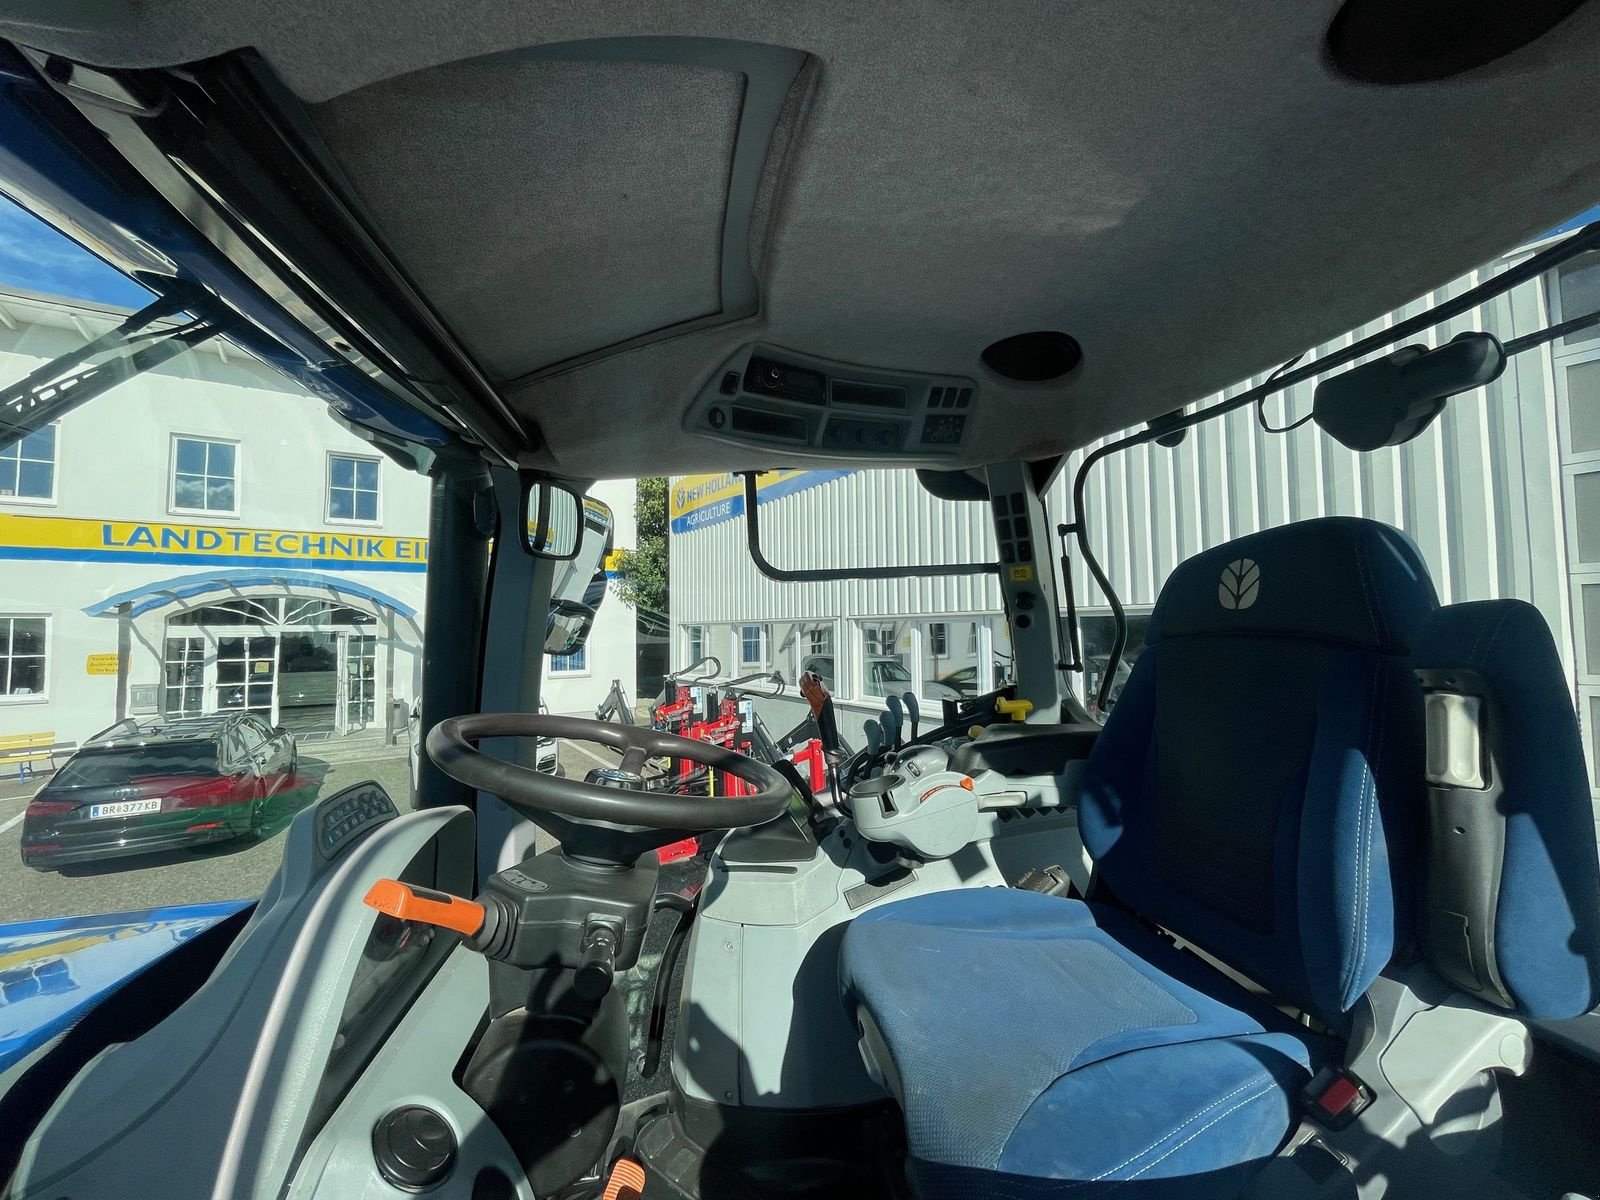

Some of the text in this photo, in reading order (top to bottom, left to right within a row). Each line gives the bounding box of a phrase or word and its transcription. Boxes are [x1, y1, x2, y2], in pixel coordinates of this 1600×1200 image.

[687, 484, 704, 502] NEW
[686, 502, 730, 526] AGRICULTURE
[102, 524, 428, 559] LANDTECHNIK EI
[102, 806, 115, 815] BR
